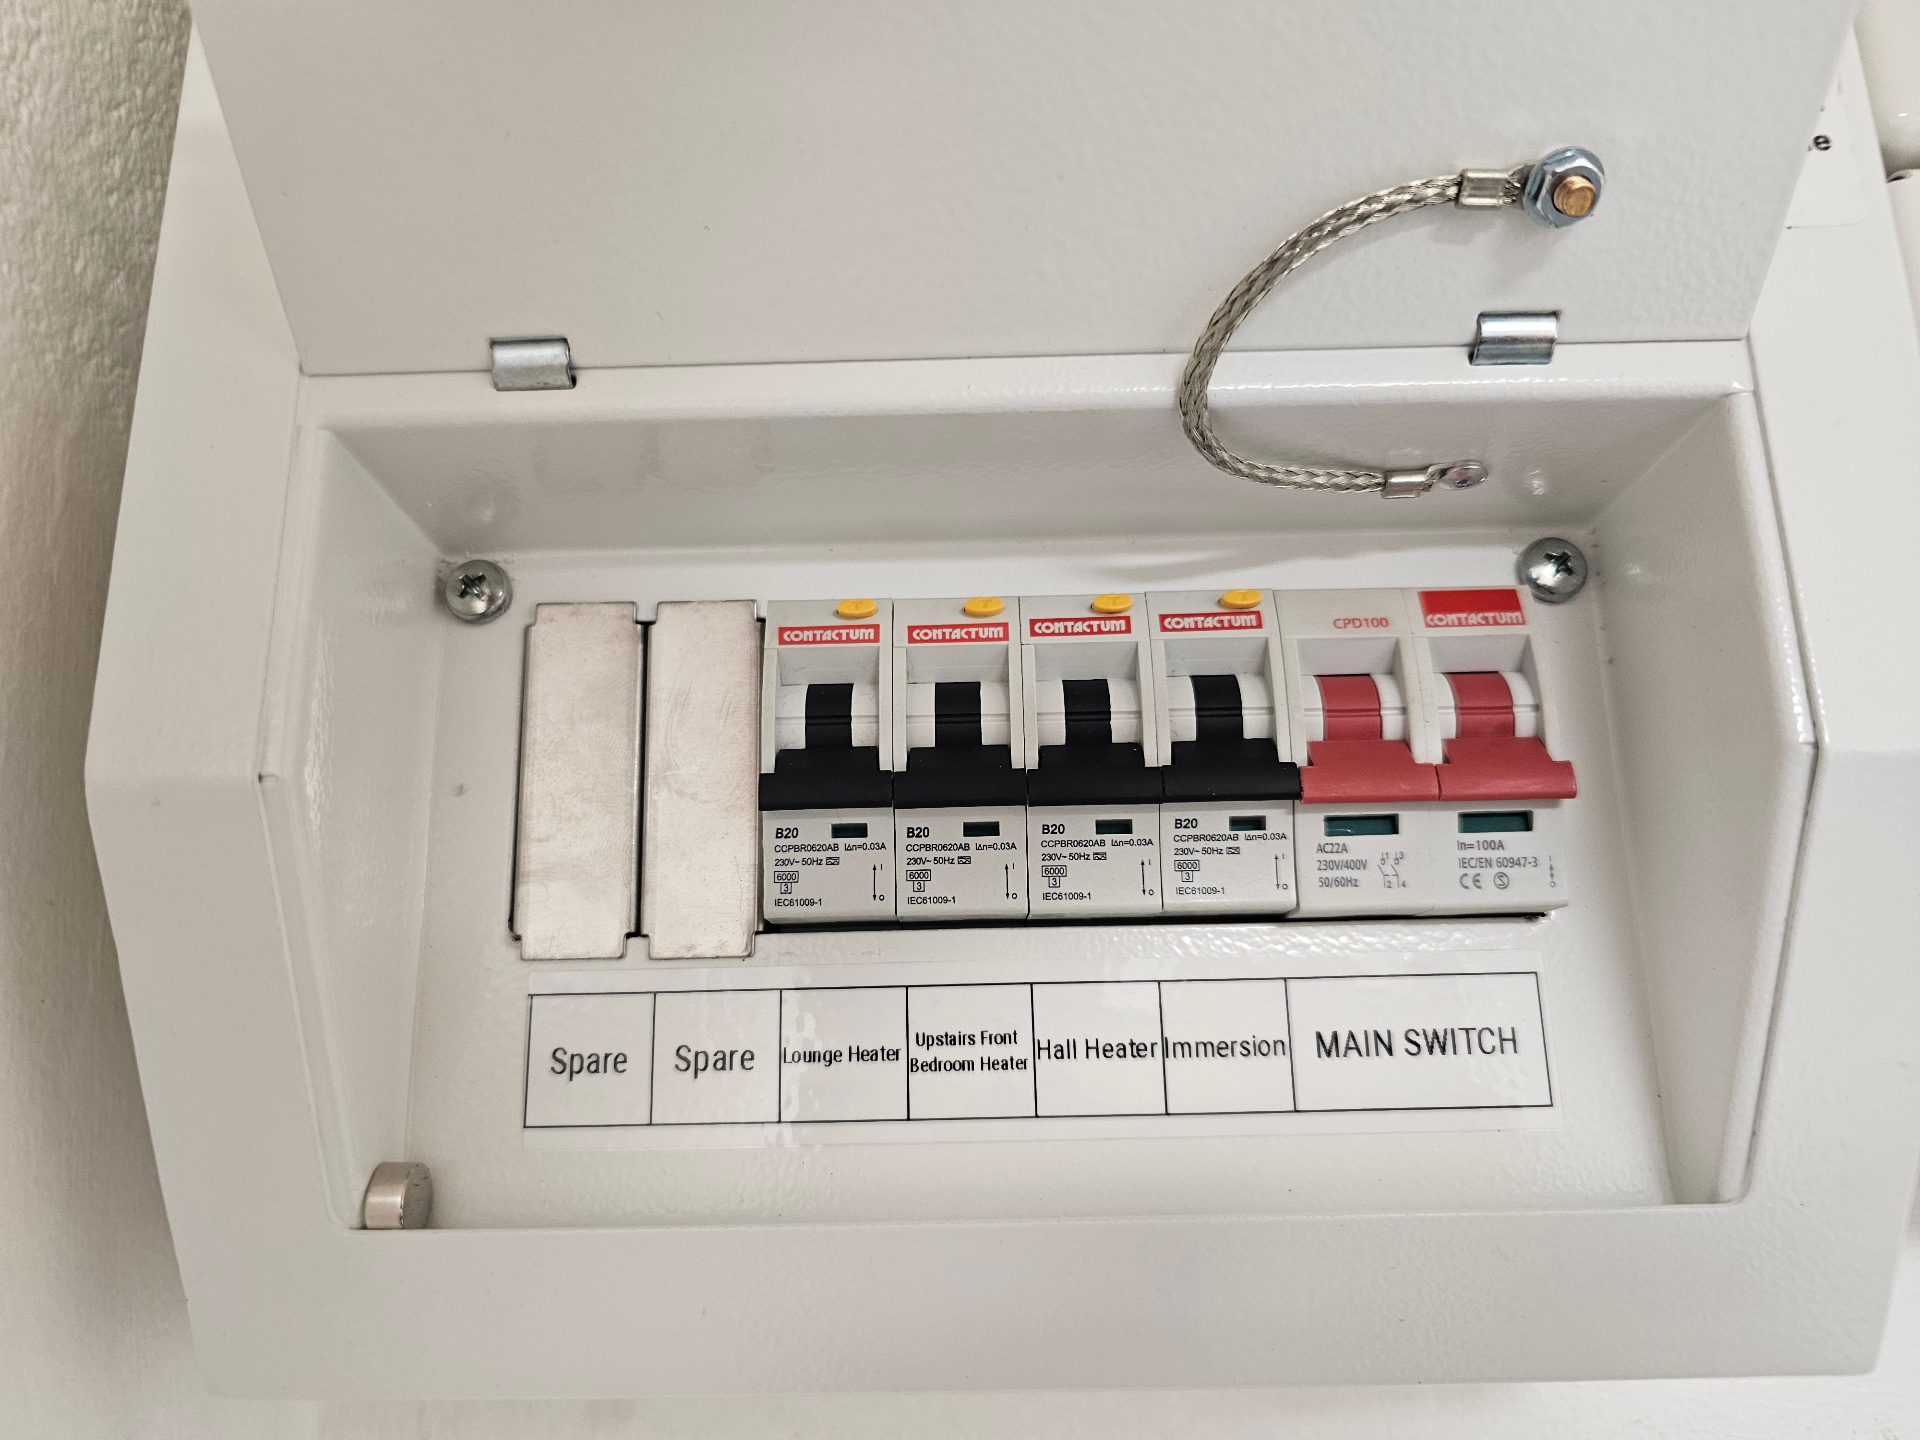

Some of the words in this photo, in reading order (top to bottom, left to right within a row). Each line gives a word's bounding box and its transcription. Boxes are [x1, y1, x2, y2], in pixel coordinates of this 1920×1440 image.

[1163, 614, 1257, 630] CONTACTUM
[1332, 617, 1390, 629] CPD100
[1425, 612, 1523, 626] CONTACTUM
[1033, 620, 1126, 634] CONTACTUM
[783, 628, 875, 642] CONTACTUM
[912, 627, 1003, 640] CONTACTUM
[1041, 823, 1065, 835] B20
[1174, 818, 1198, 829] B20
[775, 827, 799, 839] B20
[906, 827, 930, 838] B20
[1173, 833, 1239, 842] CCPBR0620AB
[774, 843, 839, 853] CCPBR0620AB
[905, 843, 971, 852] CCPBR0620AB
[1040, 839, 1106, 848] CCPBR0620AB
[1316, 843, 1348, 854] AC22A
[1457, 840, 1505, 851] In=100A
[1201, 846, 1224, 855] 50Hz
[801, 857, 823, 866] 50Hz
[933, 856, 955, 865] 50Hz
[1068, 852, 1091, 861] 50Hz
[1177, 862, 1198, 870] 6000
[1316, 859, 1367, 871] 230V/400V
[1458, 857, 1493, 869] IEC/EN
[1495, 856, 1538, 868] 60947-3
[909, 872, 929, 880] 6000
[1044, 867, 1065, 875] 6000
[1185, 872, 1190, 880] 3
[776, 873, 797, 881] 6000
[1052, 878, 1057, 886] 3
[1318, 876, 1359, 888] 50/60Hz
[1459, 873, 1482, 890] CE
[783, 884, 789, 893] 3
[916, 882, 922, 890] 3
[1386, 880, 1392, 888] 2
[1401, 880, 1407, 888] 4
[1042, 892, 1091, 901] IEC61009-1
[1175, 887, 1225, 895] IEC61009-1
[774, 898, 822, 907] IEC61009-1
[907, 896, 956, 905] IEC61009-1
[915, 1031, 976, 1051] Upstairs
[980, 1029, 1018, 1046] Front
[1315, 1029, 1394, 1059] MAIN
[1403, 1026, 1518, 1056] SWITCH
[1037, 1037, 1077, 1060] Hall
[1085, 1037, 1158, 1060] Heater
[1164, 1034, 1286, 1060] Immersion
[783, 1046, 843, 1067] Lounge
[848, 1045, 901, 1063] Heater
[550, 1046, 628, 1082] Spare
[674, 1044, 755, 1080] Spare
[910, 1056, 975, 1073] Bedroom
[980, 1056, 1029, 1072] Heater
